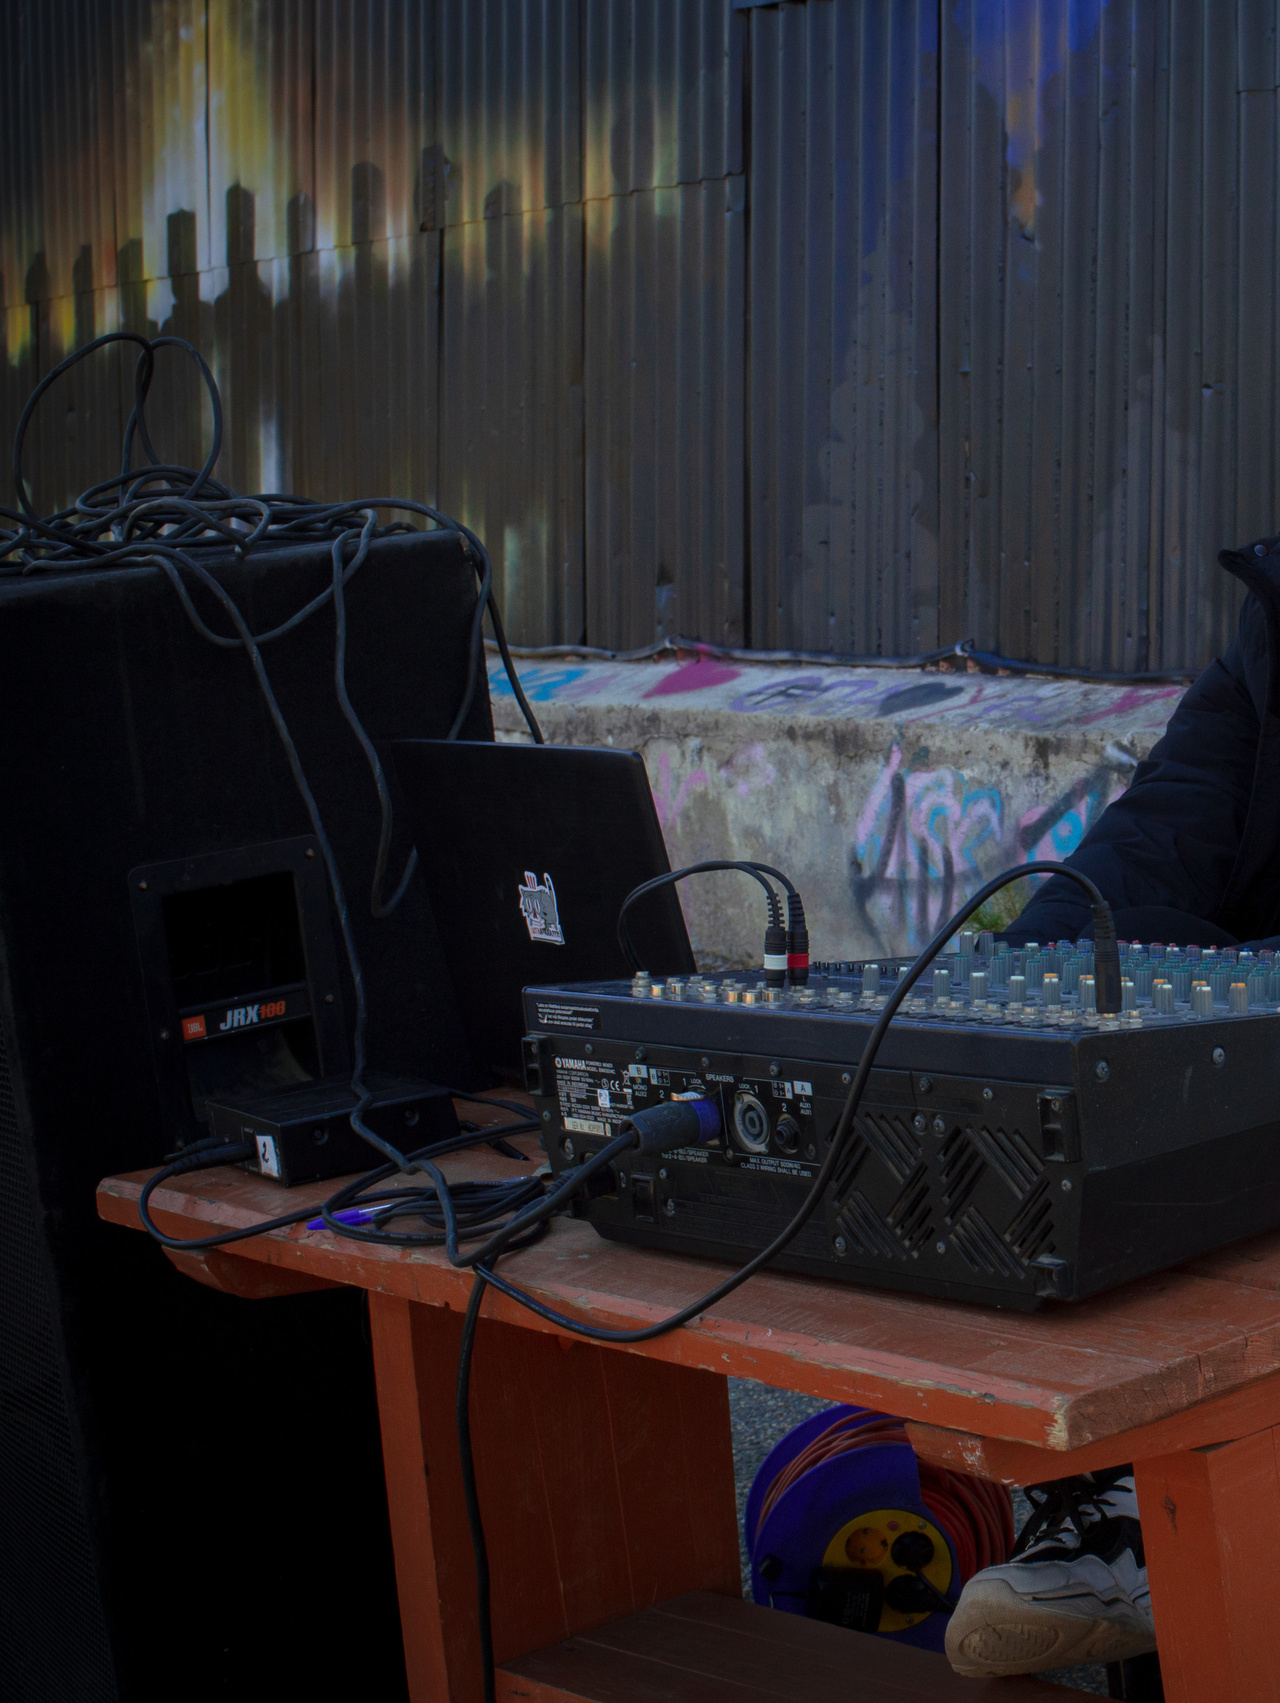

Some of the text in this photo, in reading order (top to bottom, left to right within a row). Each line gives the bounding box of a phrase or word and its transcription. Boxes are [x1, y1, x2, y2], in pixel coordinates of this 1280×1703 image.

[219, 1000, 287, 1031] JRX100
[187, 1021, 204, 1035] JBL
[561, 1057, 587, 1072] YAMAHA
[705, 1073, 735, 1083] SPEAKERS
[633, 1083, 648, 1091] MONO
[738, 1082, 751, 1090] LOCK
[659, 1089, 665, 1099] 2
[781, 1102, 787, 1112] 2
[761, 1158, 779, 1167] OUTPUT
[740, 1161, 756, 1170] CLASS
[777, 1166, 792, 1175] SHALL
